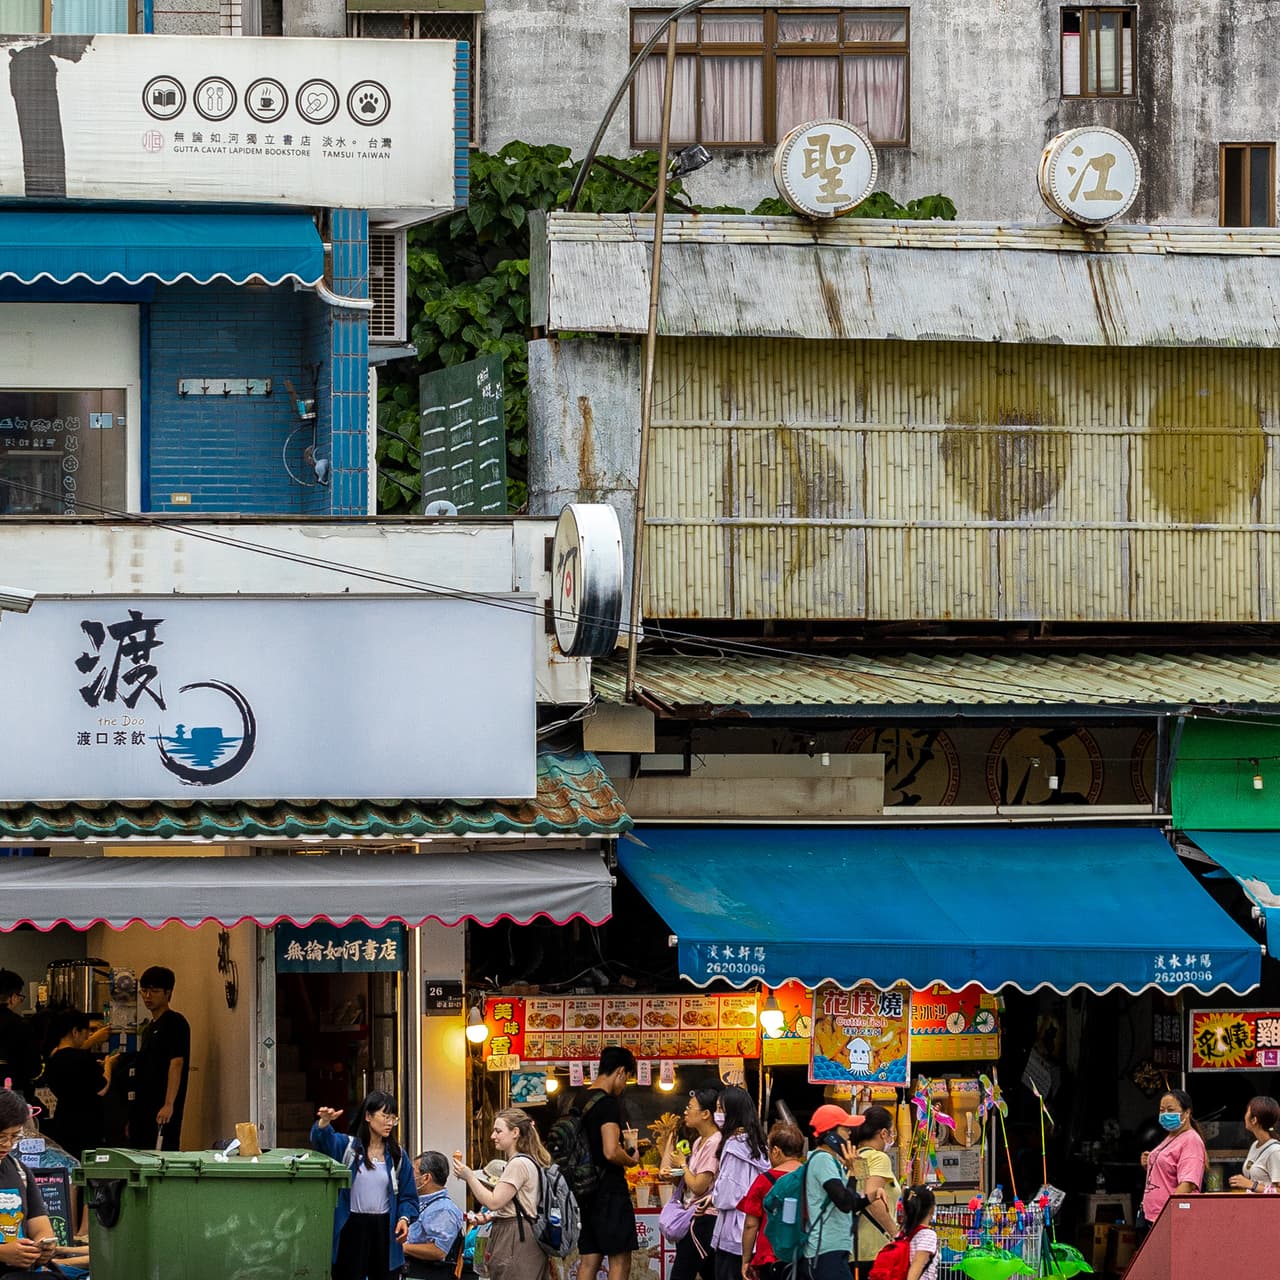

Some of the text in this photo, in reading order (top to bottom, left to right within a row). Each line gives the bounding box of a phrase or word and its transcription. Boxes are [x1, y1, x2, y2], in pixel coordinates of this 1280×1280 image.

[173, 131, 312, 147] 無論如河獨立書店
[368, 136, 393, 150] 台灣
[173, 145, 391, 160] GUTTA CAVAT LAPIDEM BOOKSTORE TAMSUI TAIWAN
[801, 133, 856, 204] 聖
[1067, 145, 1124, 203] 江
[74, 608, 167, 711] 渡
[98, 715, 145, 727] the Doo
[76, 730, 146, 746] 渡口茶飲
[283, 937, 398, 962] 無論如河書店
[706, 962, 766, 974] 26203096
[1154, 970, 1213, 983] 26203096
[429, 986, 443, 997] 26
[823, 989, 904, 1018] 花枝燒
